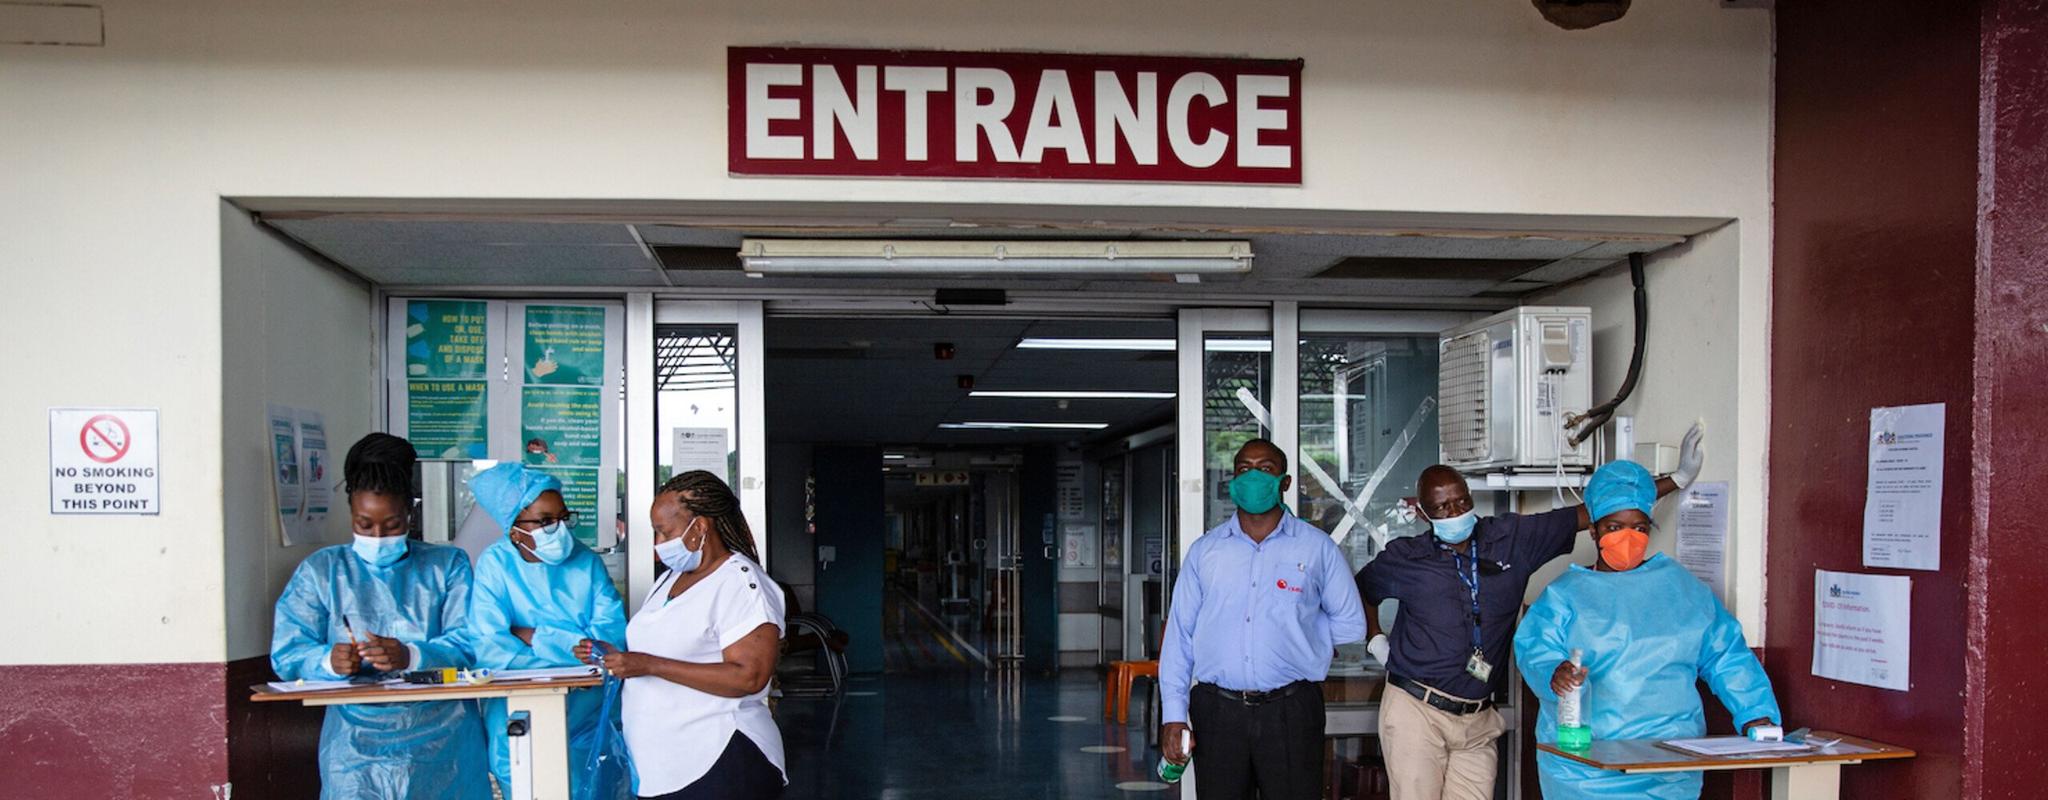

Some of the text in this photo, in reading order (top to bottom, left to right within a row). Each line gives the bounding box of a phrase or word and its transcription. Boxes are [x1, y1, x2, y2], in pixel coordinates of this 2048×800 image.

[746, 63, 1292, 168] ENTRANCE
[410, 383, 430, 392] WHEN
[56, 467, 154, 478] NO SMOKING
[74, 483, 136, 493] BEYOND
[62, 499, 149, 509] THIS POINT
